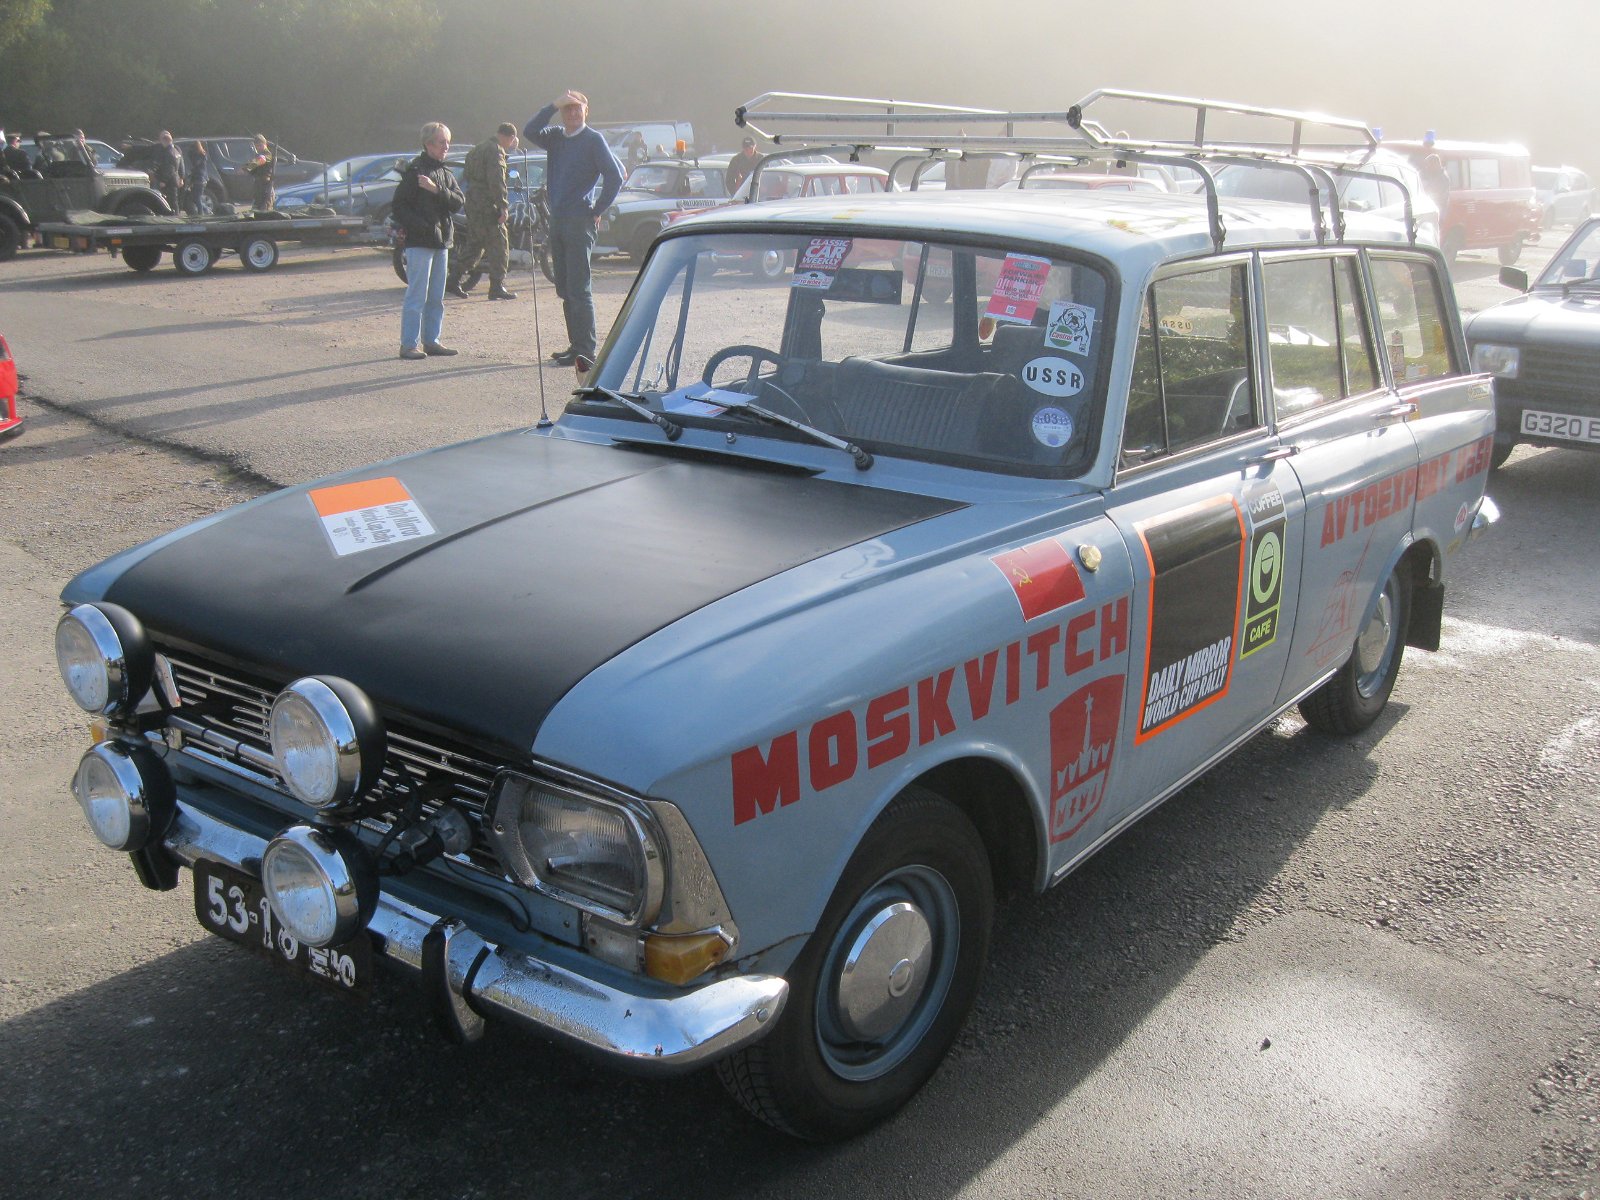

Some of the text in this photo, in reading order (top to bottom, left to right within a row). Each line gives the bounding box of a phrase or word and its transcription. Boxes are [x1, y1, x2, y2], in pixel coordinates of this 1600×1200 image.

[805, 245, 846, 259] CAR
[811, 238, 850, 246] CLASSIC
[802, 256, 839, 265] WEEKLY
[1051, 331, 1073, 341] Castrol
[1026, 366, 1080, 389] USSR
[1525, 413, 1582, 437] G320
[1250, 490, 1282, 514] COFFEE
[1320, 452, 1450, 549] AVTOEXPORT
[1147, 636, 1231, 705] DAILY MIRROR
[1142, 664, 1228, 730] WORLD CUP RALLY
[731, 595, 1129, 827] MOSKVITCH
